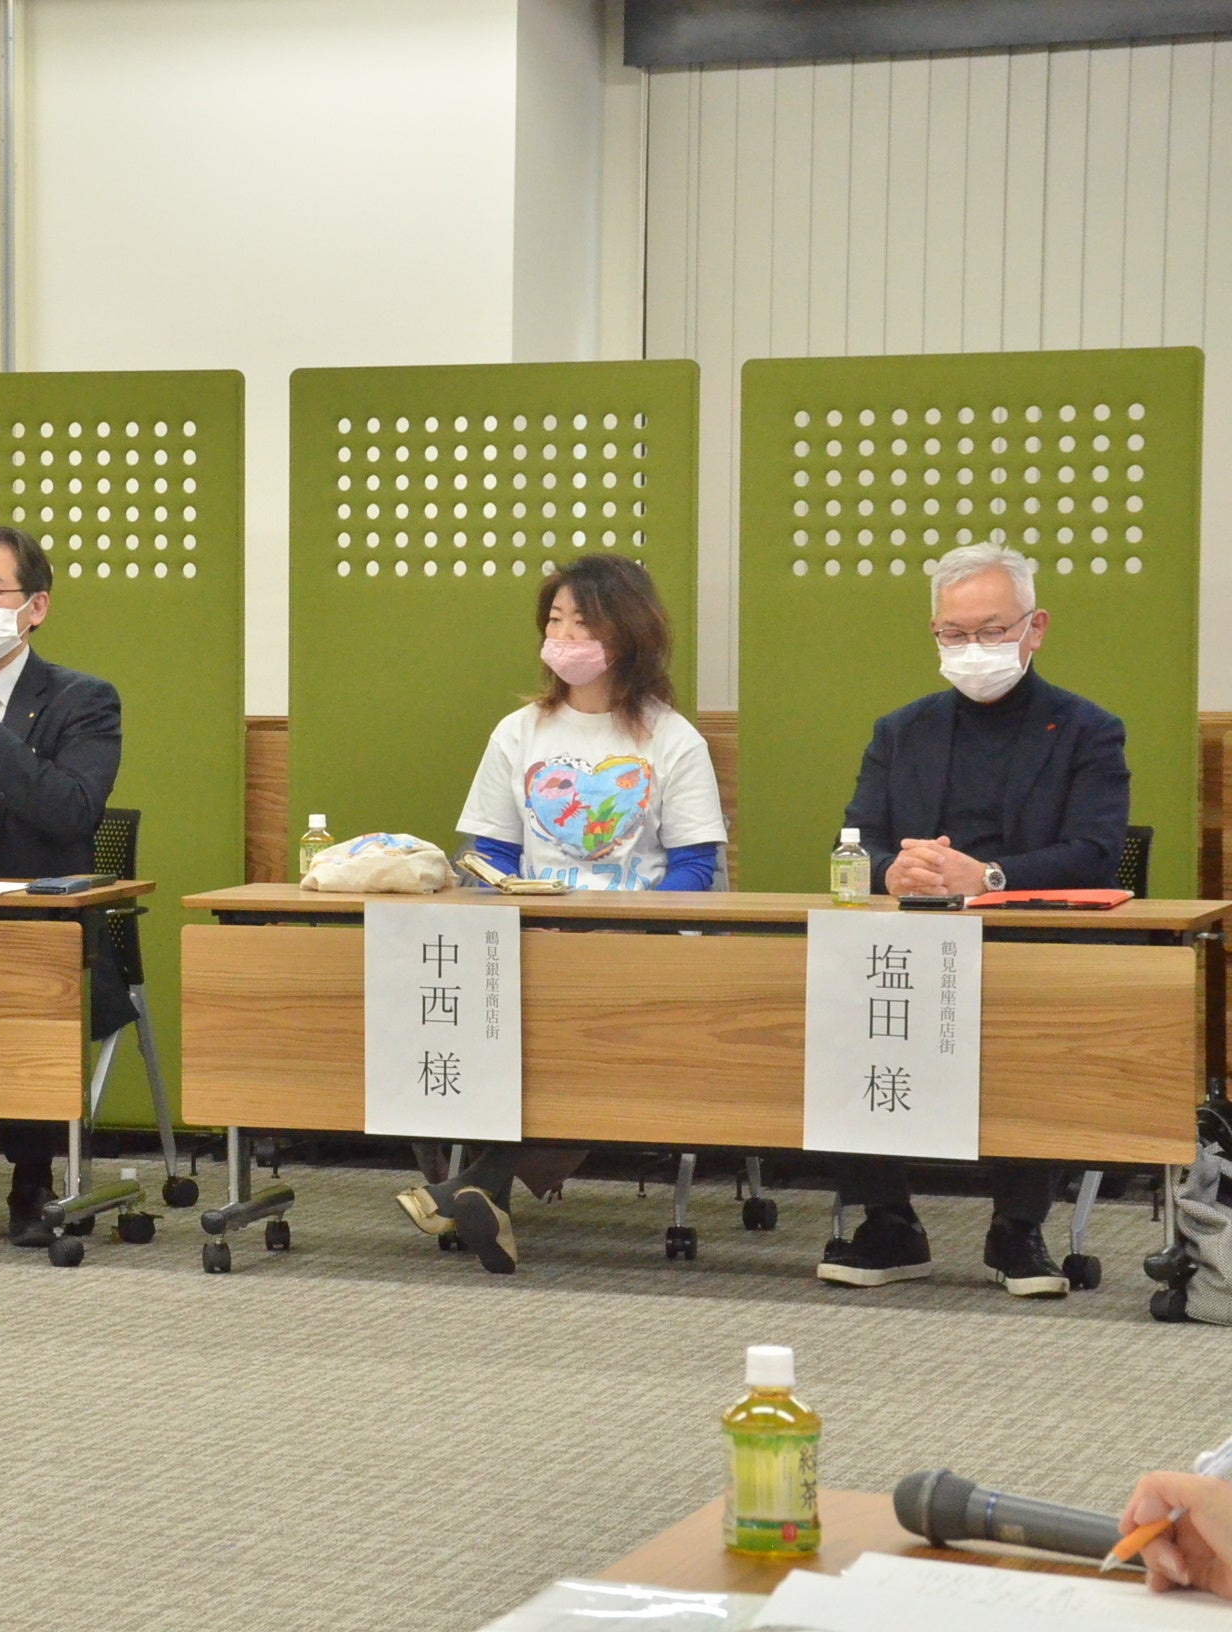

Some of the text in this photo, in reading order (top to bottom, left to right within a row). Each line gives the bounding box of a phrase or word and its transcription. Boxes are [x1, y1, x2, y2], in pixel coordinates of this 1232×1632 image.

[485, 930, 500, 1040] 鶴見銀座商店街
[939, 940, 958, 1055] 鶴見銀座商店街
